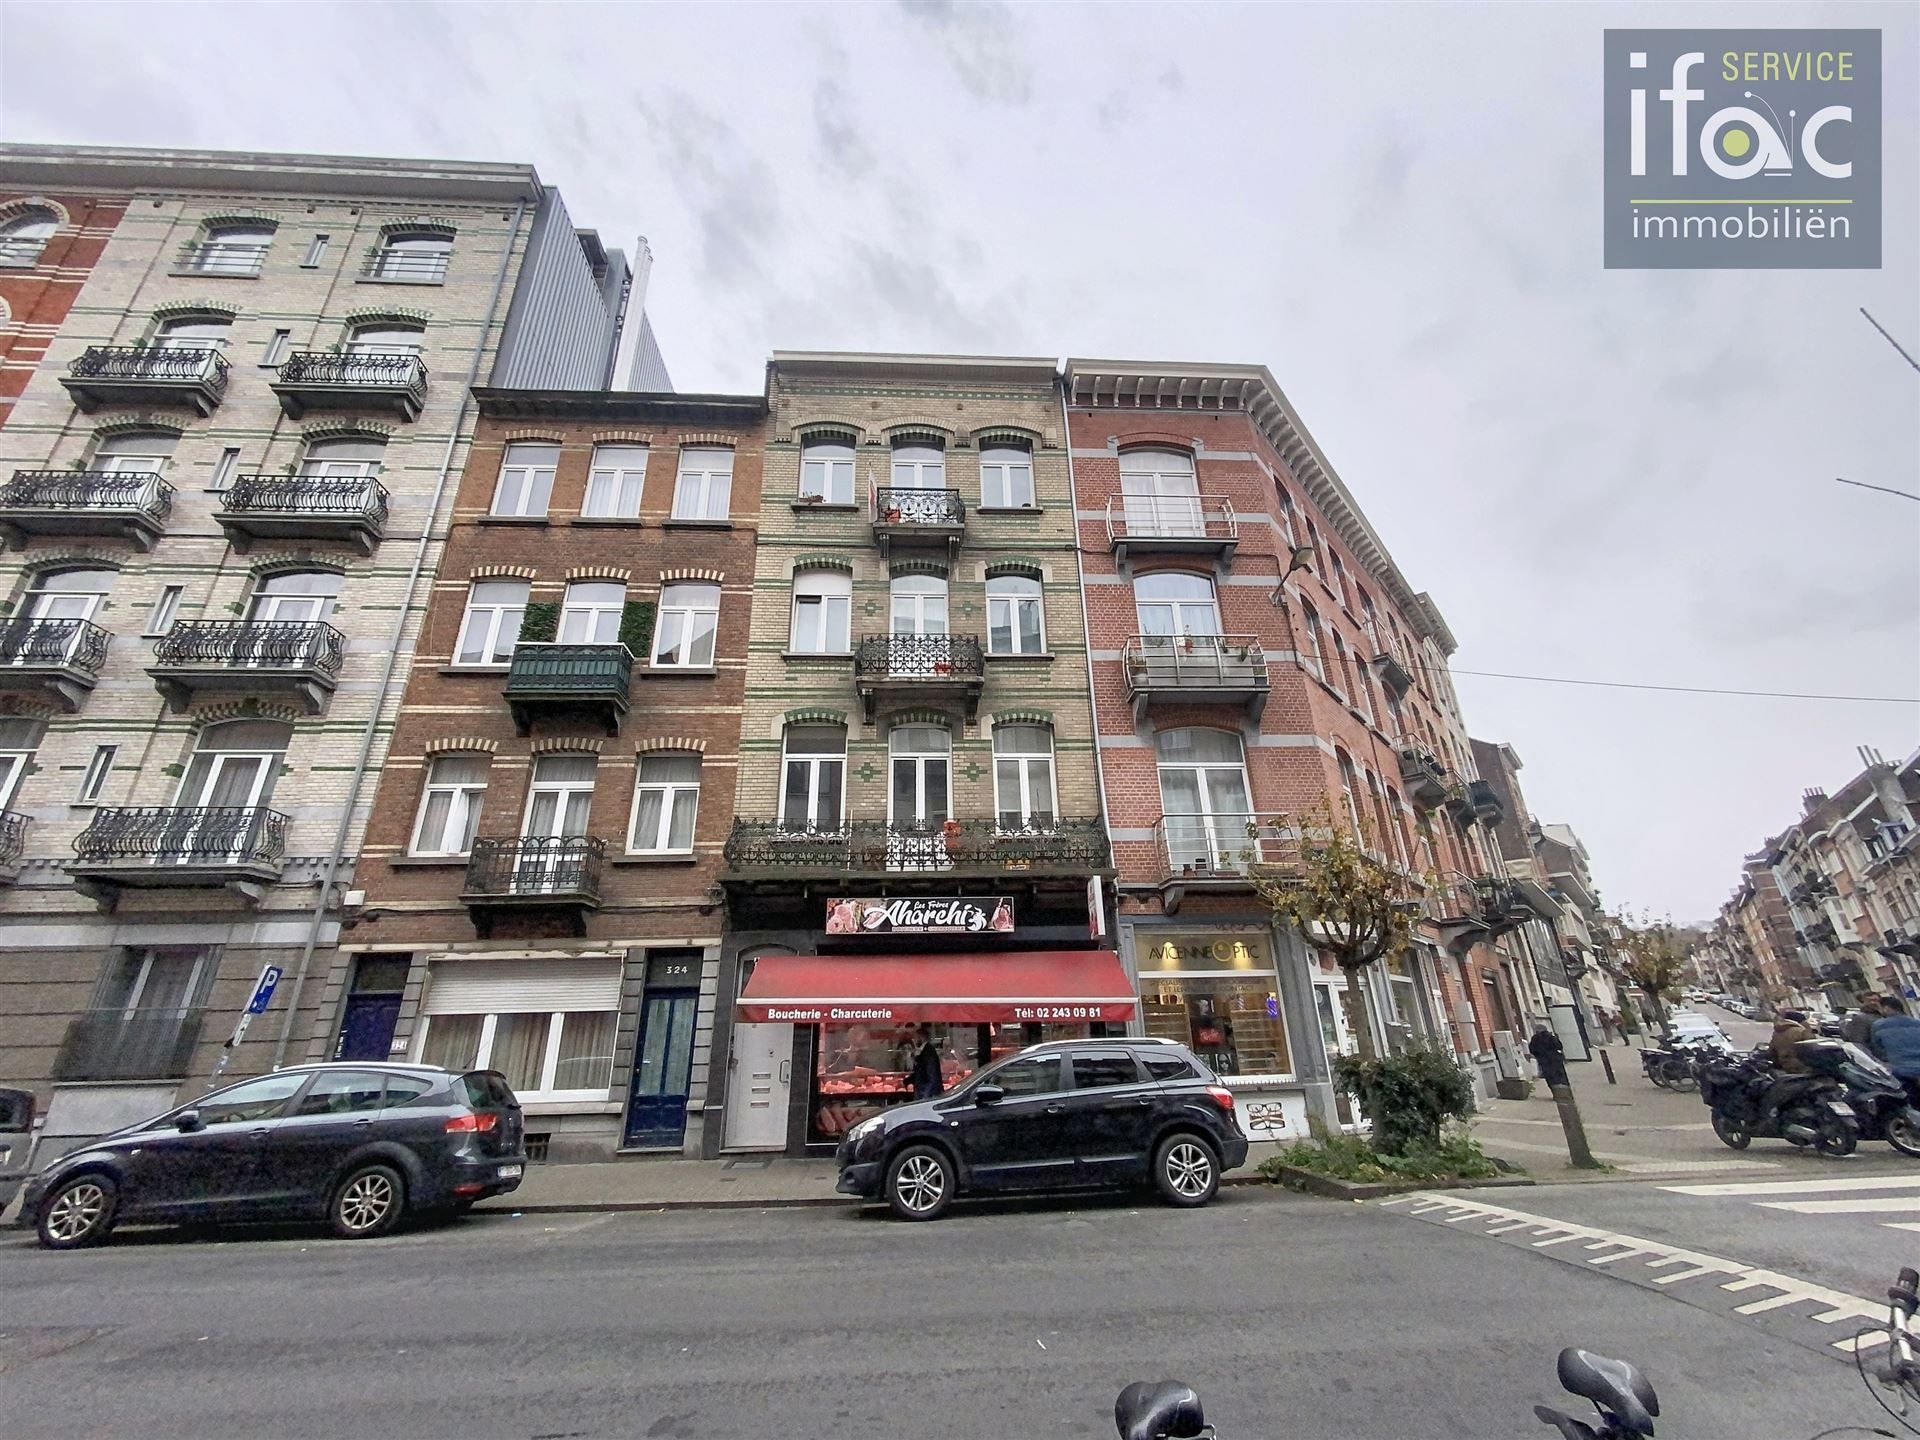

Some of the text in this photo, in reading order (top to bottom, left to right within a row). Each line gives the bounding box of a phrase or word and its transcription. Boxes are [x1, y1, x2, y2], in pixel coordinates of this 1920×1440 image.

[863, 900, 972, 929] Aharchi
[666, 966, 688, 974] 324
[260, 970, 278, 994] P
[768, 1008, 821, 1019] Boucherie
[830, 1008, 892, 1019] Charcuterie
[1014, 1007, 1101, 1018] Tél: 02 243 09 81
